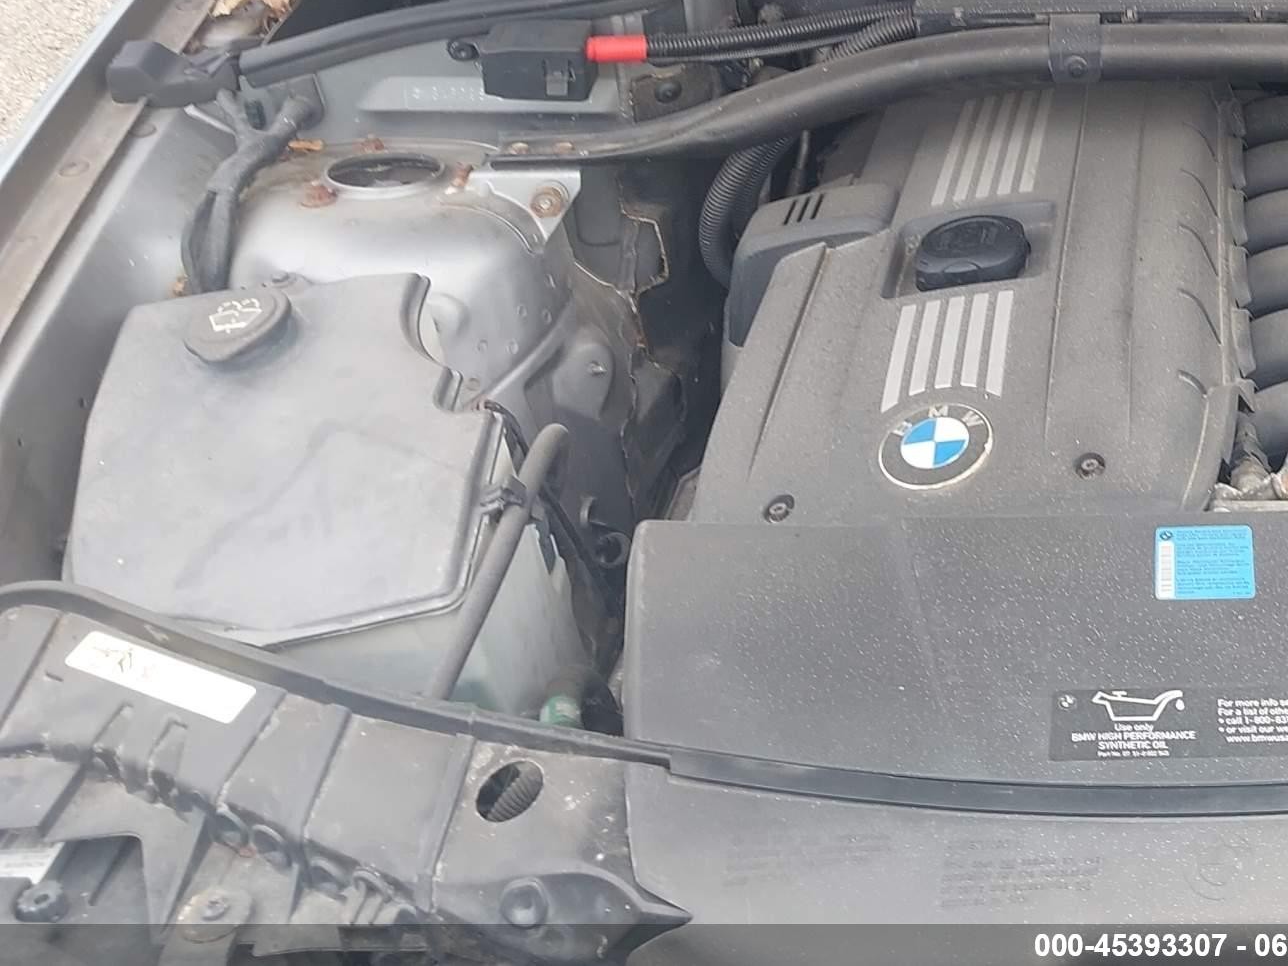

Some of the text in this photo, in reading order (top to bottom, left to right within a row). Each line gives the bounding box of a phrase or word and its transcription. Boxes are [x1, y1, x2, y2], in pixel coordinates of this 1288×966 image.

[892, 404, 984, 436] BMW
[1217, 698, 1233, 707] For
[1235, 699, 1259, 707] more
[1260, 698, 1279, 707] info
[1217, 707, 1234, 716] For
[1242, 707, 1258, 716] list
[1258, 707, 1268, 716] of
[1225, 716, 1243, 725] call
[1114, 722, 1154, 733] Use only
[1225, 726, 1238, 734] or
[1258, 725, 1275, 733] our
[1071, 730, 1197, 742] BMW HIGH PERFORMANCE
[1098, 740, 1169, 750] SYNTHETIC OIL
